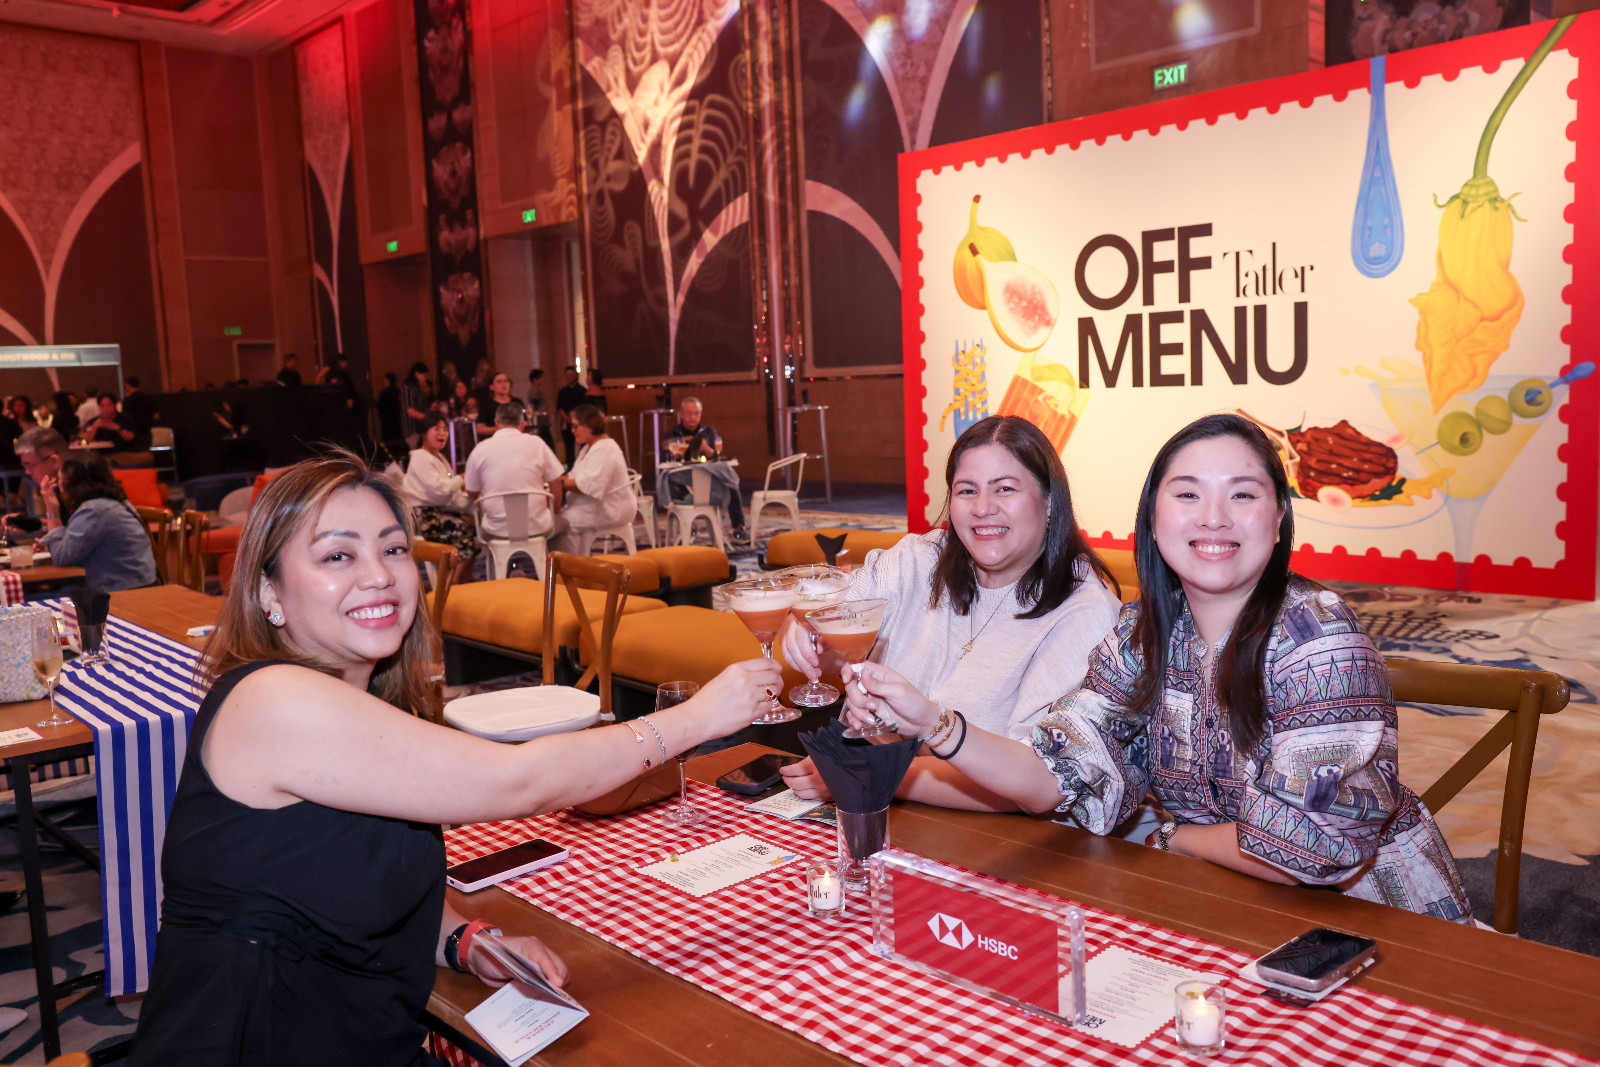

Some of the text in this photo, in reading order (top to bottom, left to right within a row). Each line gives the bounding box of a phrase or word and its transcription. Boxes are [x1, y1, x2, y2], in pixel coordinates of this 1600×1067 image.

[1154, 64, 1188, 88] EXIT
[1074, 222, 1213, 311] OFF
[1222, 241, 1315, 298] Tatler
[1077, 301, 1309, 389] MENU
[977, 934, 1019, 961] HSBC
